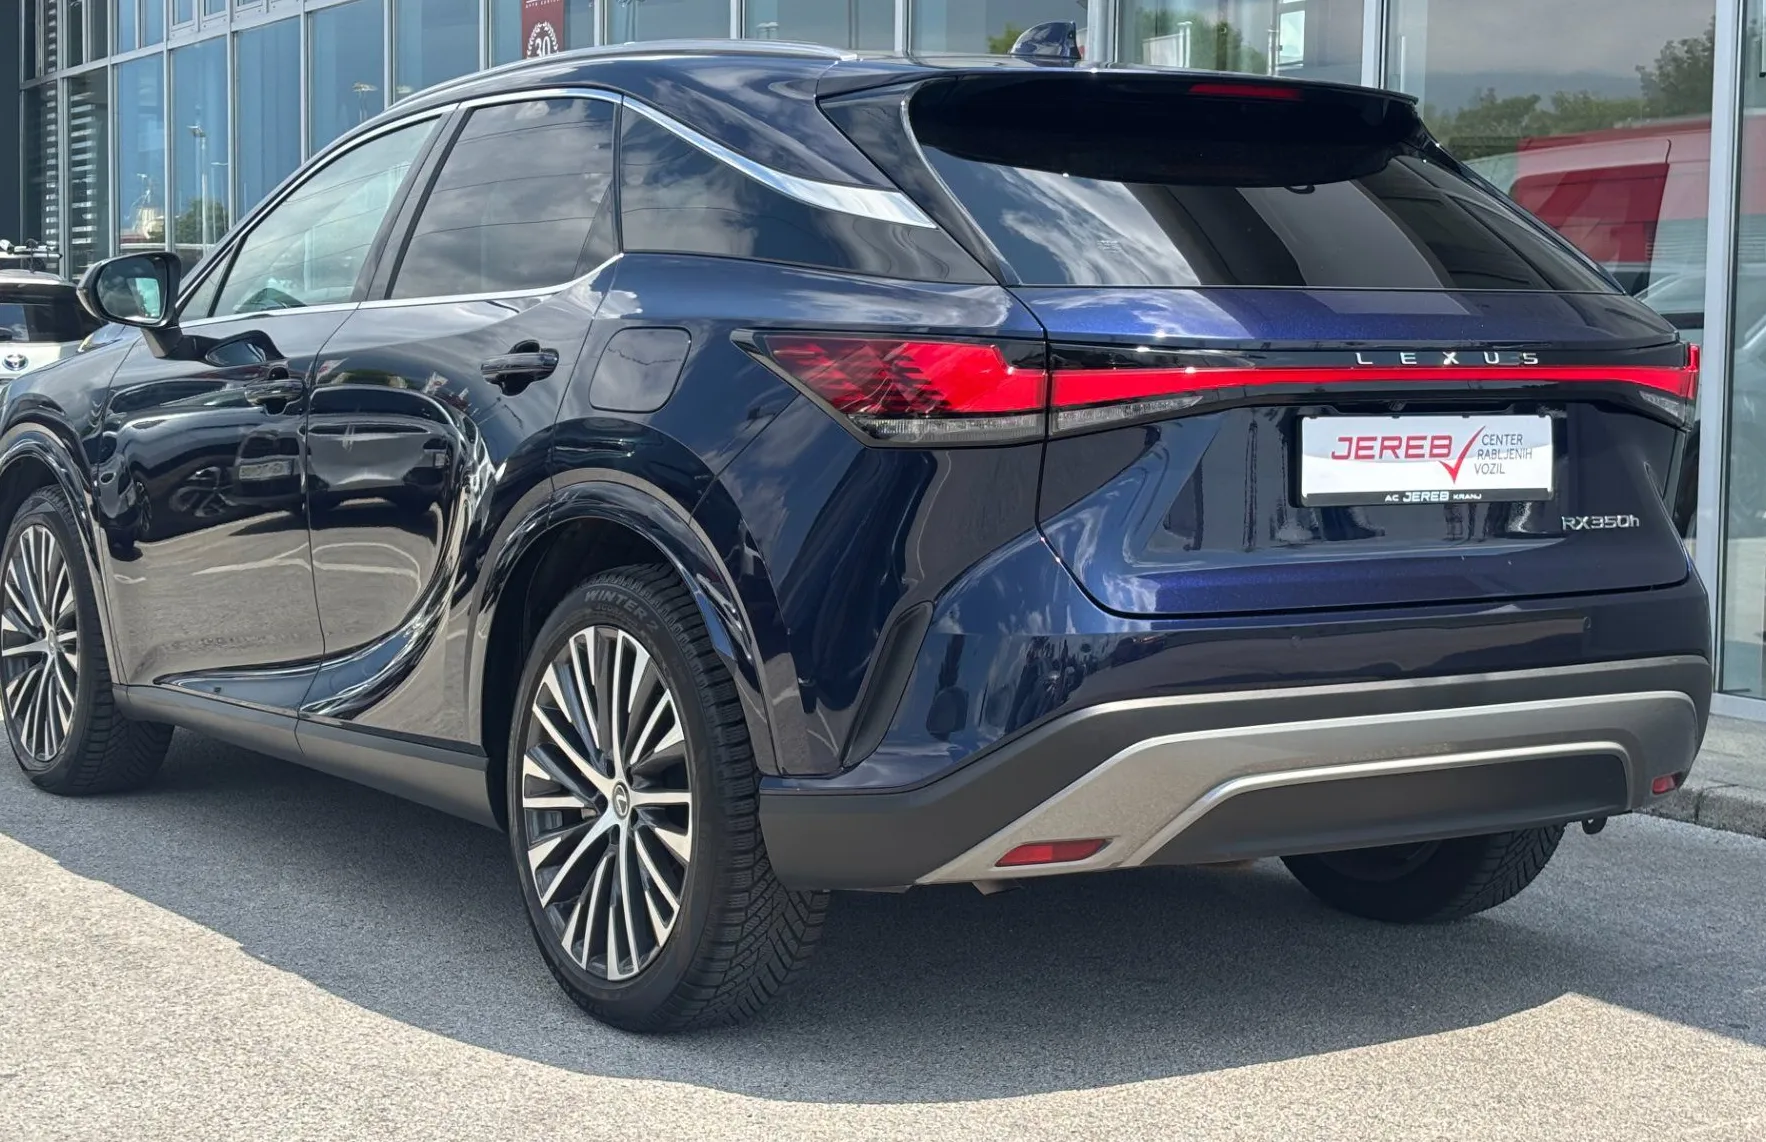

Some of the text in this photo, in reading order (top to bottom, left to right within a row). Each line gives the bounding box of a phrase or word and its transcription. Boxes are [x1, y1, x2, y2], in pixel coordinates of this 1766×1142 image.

[1355, 351, 1539, 365] LEXUS
[1481, 433, 1523, 446] CENTER
[1331, 435, 1453, 461] JEREB
[1477, 448, 1533, 460] RABLJENIH
[1474, 463, 1506, 475] VOZIL
[1385, 494, 1399, 502] AC
[1402, 491, 1450, 502] JEREB
[1561, 514, 1640, 531] RX350h
[585, 589, 648, 620] WINTER
